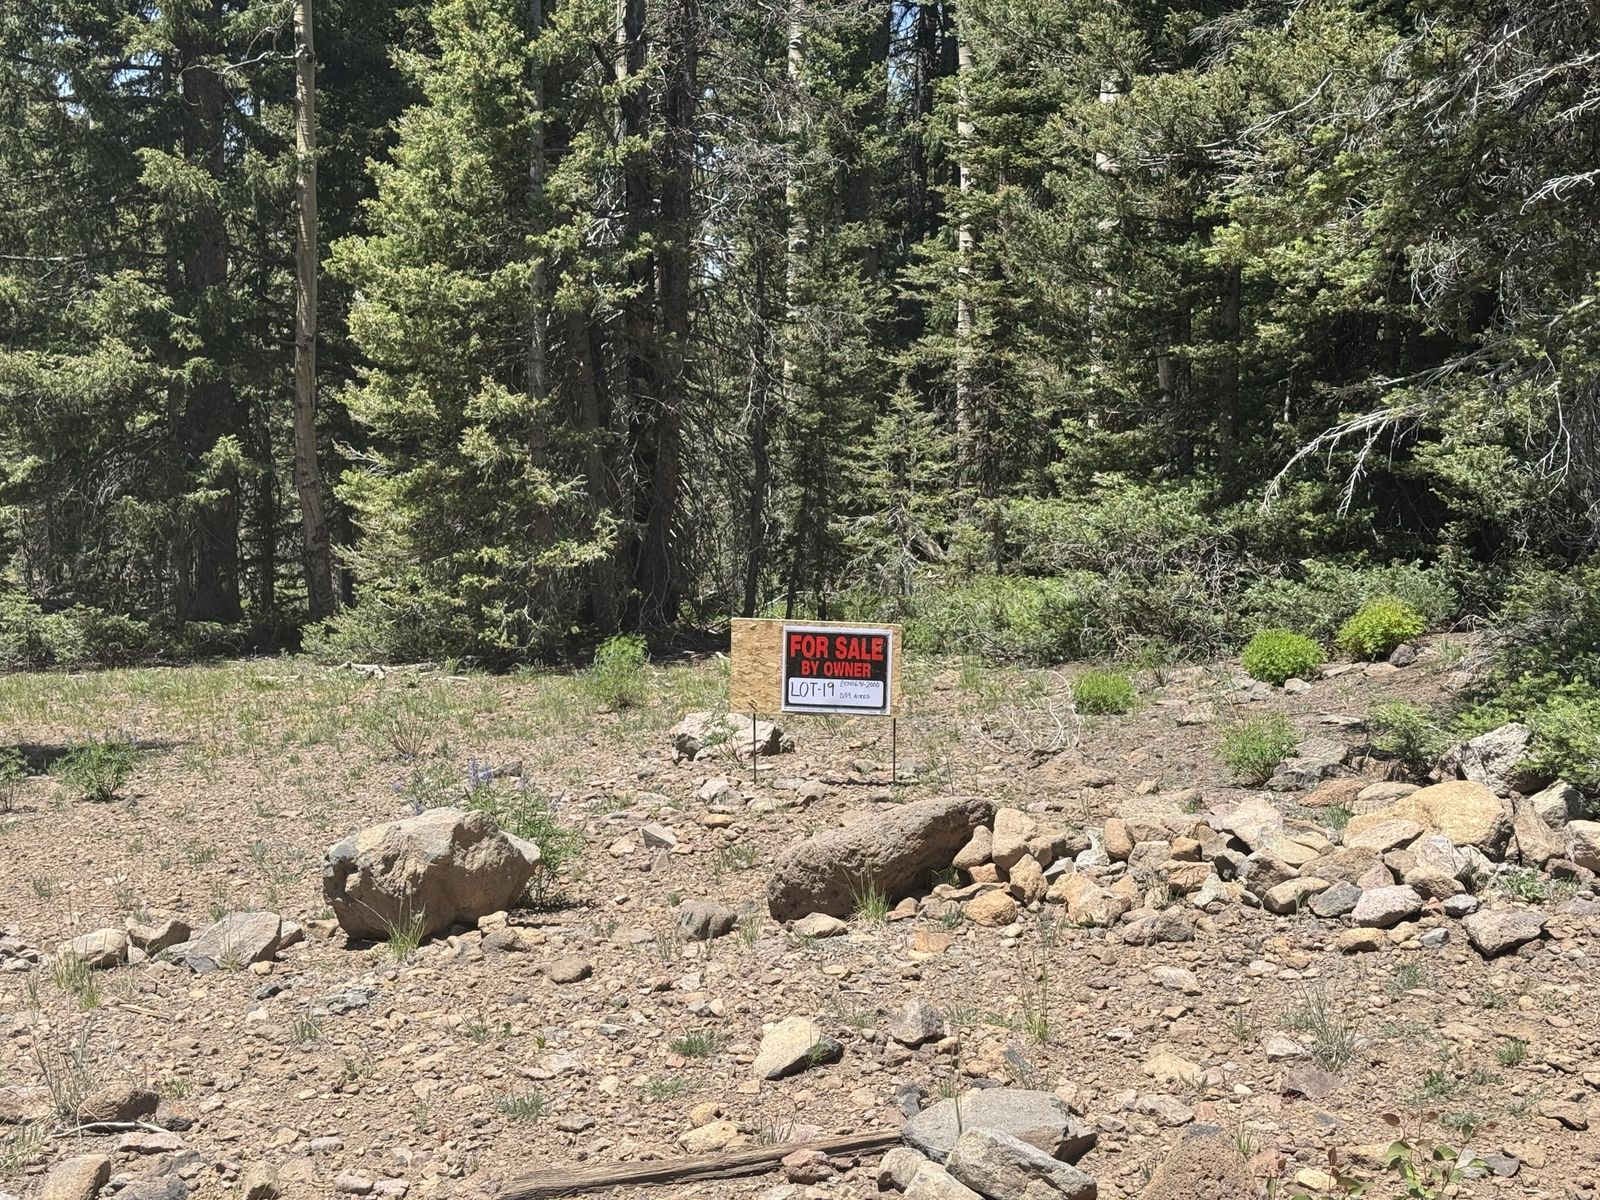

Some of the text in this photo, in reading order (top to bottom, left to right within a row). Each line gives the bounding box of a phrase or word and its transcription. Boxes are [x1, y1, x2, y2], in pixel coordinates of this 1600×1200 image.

[790, 634, 884, 660] FOR SALE
[801, 660, 872, 678] BY OWNER
[791, 681, 835, 697] LOT-19
